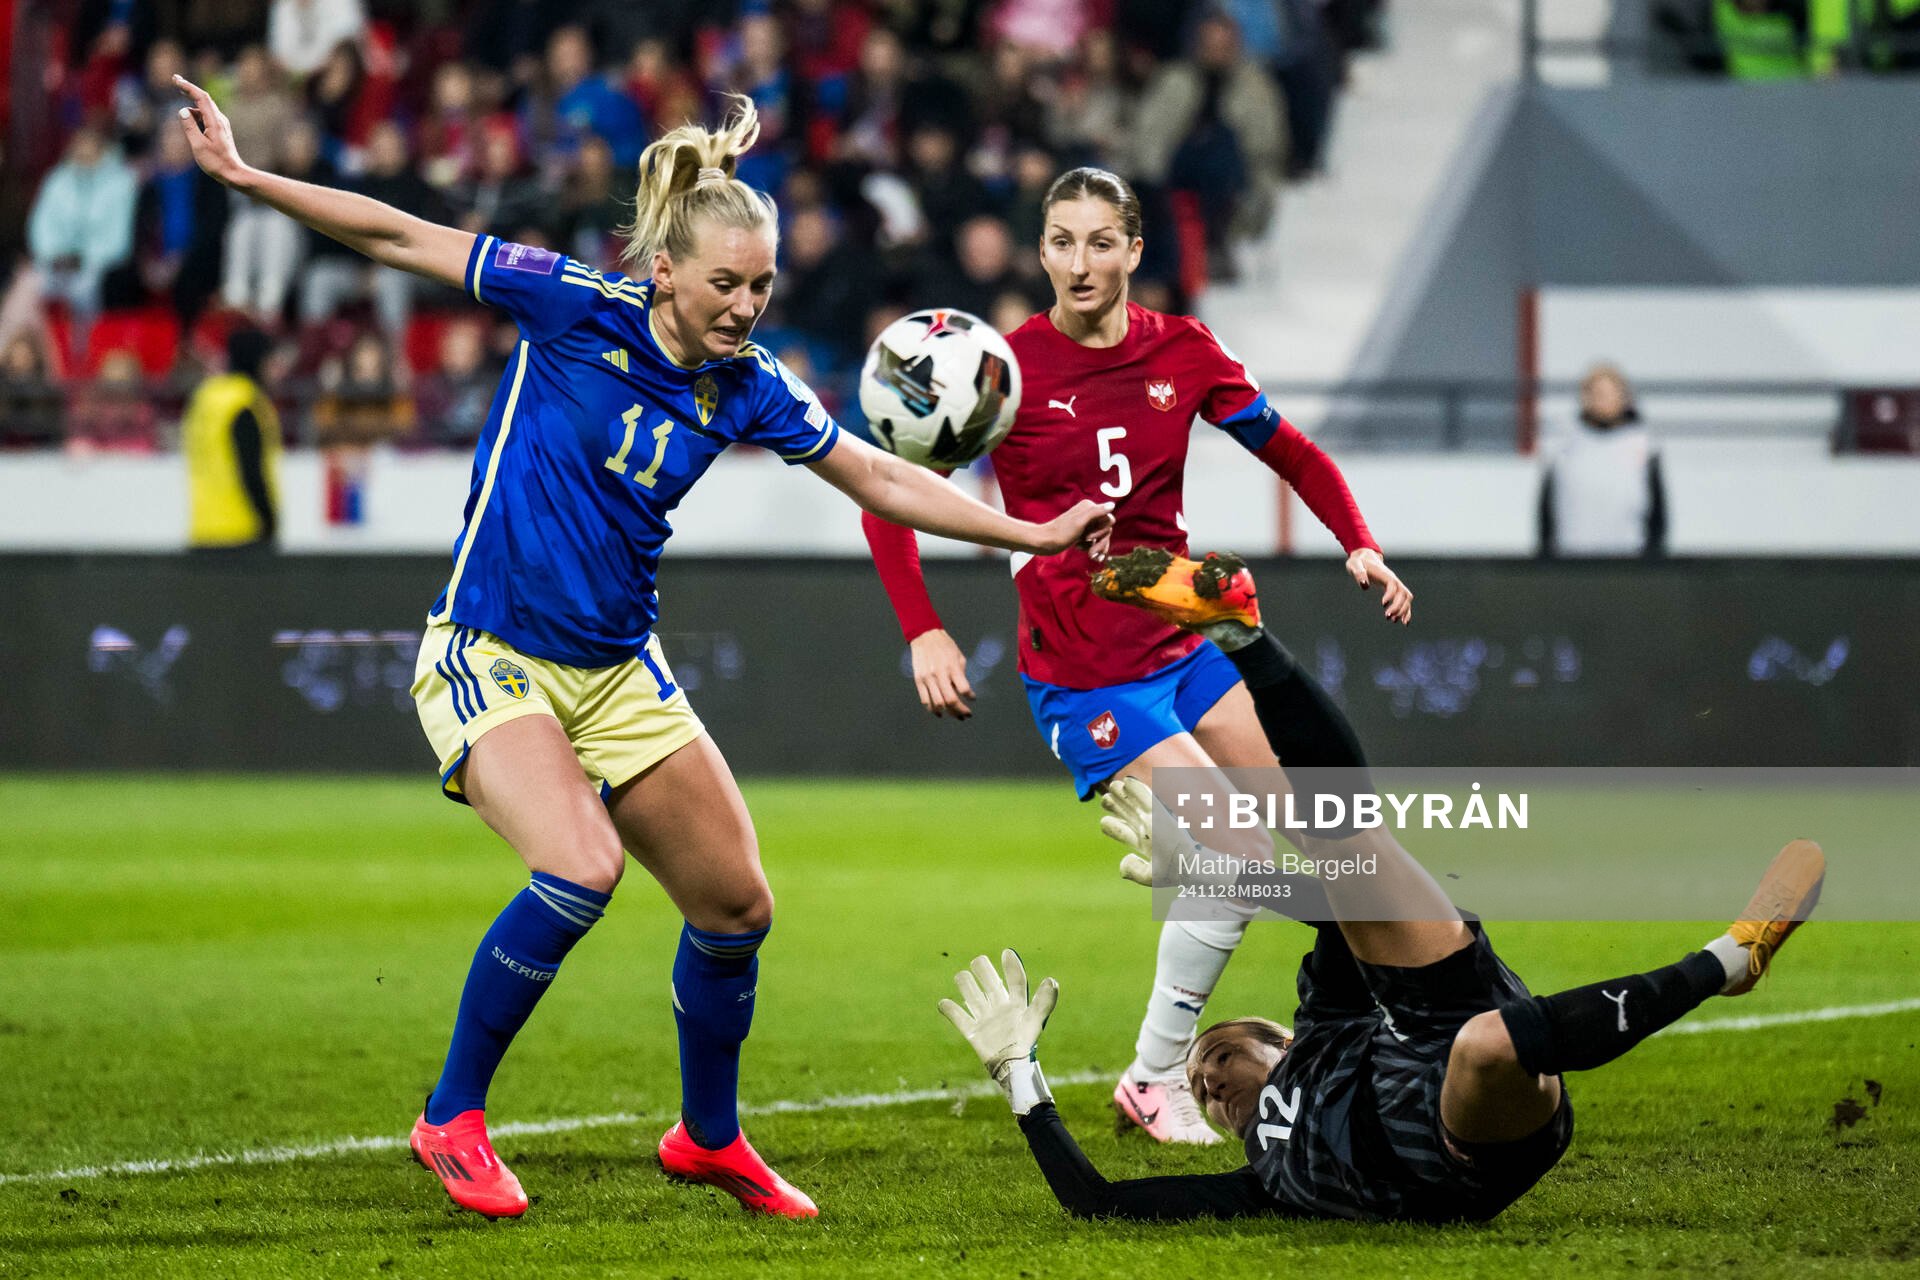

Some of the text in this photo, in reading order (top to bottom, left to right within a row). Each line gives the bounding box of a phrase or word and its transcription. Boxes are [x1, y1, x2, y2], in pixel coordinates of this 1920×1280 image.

[604, 403, 675, 488] 11
[1097, 427, 1132, 497] 5
[1257, 1084, 1301, 1151] 12
